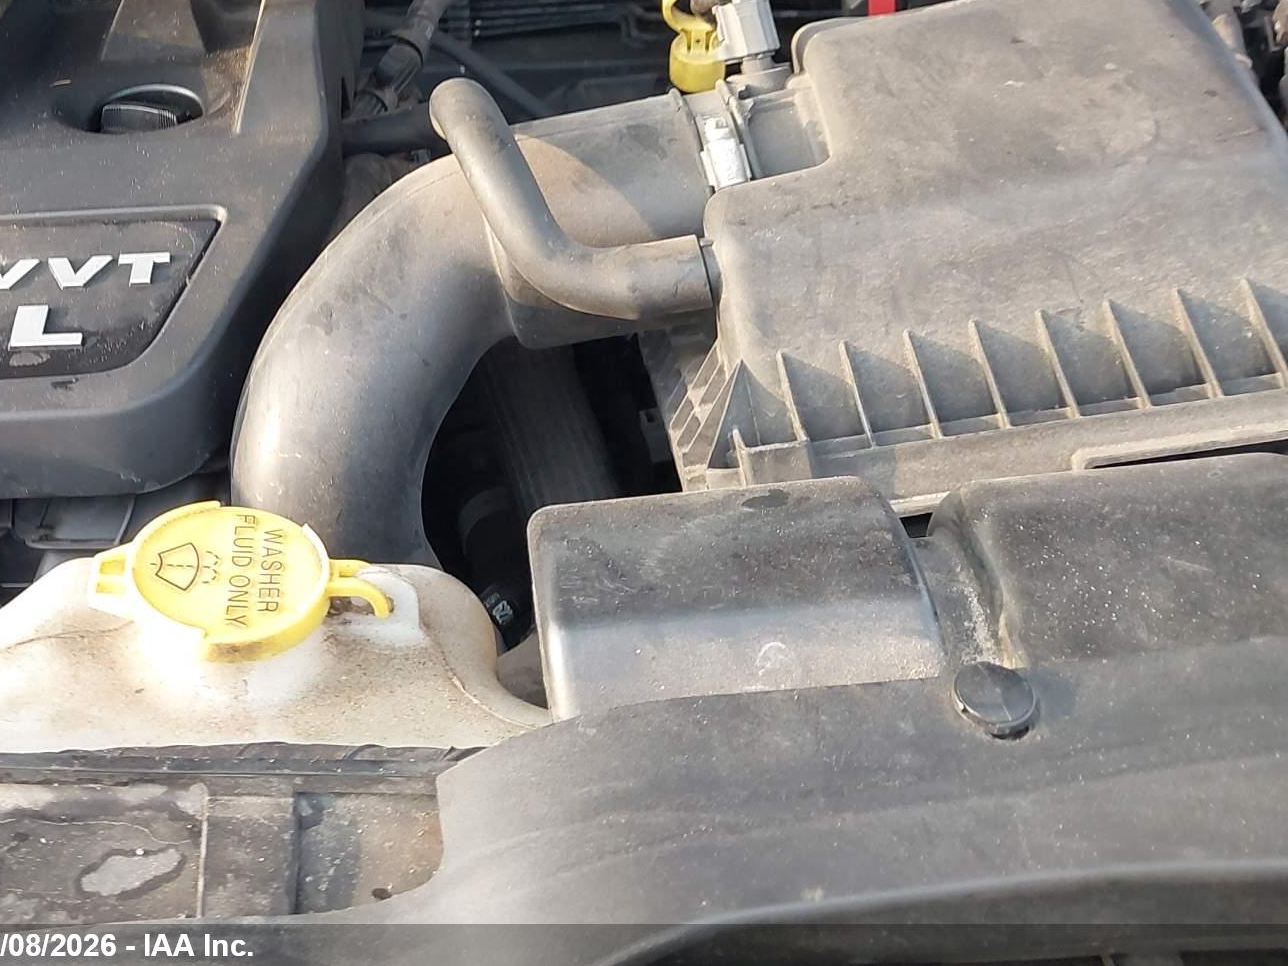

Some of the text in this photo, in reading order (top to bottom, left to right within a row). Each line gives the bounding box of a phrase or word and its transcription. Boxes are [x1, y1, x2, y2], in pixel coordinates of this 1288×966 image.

[224, 514, 256, 627] FLUID ONLY
[257, 529, 284, 613] WASHER
